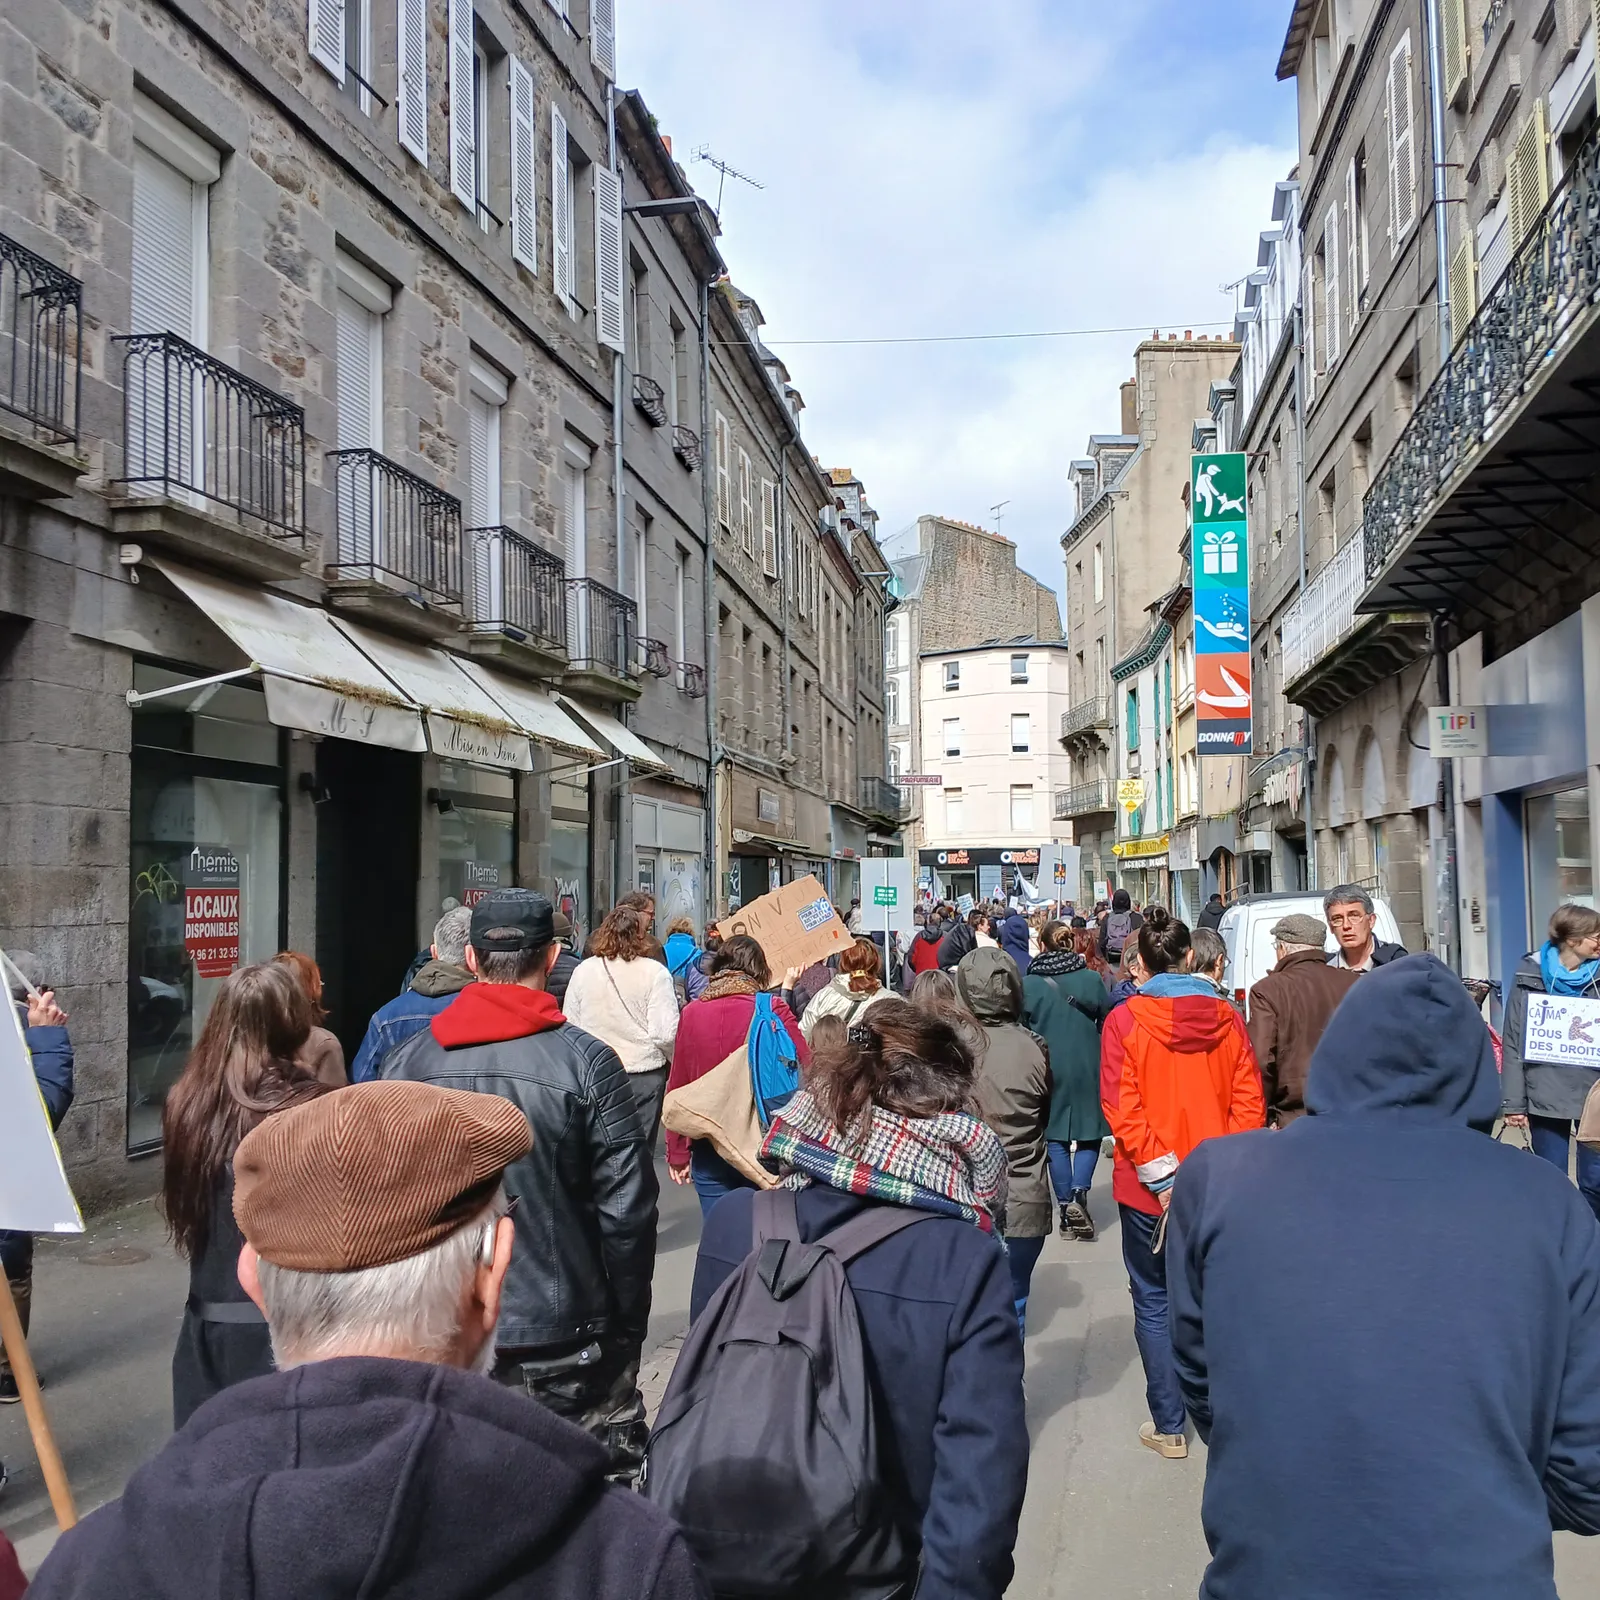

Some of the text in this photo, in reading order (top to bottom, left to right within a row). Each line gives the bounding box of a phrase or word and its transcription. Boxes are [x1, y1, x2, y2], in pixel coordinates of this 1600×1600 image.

[443, 724, 474, 754] Mise
[476, 744, 489, 757] en
[1198, 731, 1251, 746] BONNAMY
[186, 895, 238, 919] LOCAUX
[185, 921, 239, 939] DISPONIBLES
[196, 948, 207, 961] 96
[208, 947, 217, 960] 21
[218, 947, 228, 959] 32
[229, 946, 239, 958] 35
[1530, 1028, 1562, 1039] TOUS
[1529, 1041, 1553, 1051] DES
